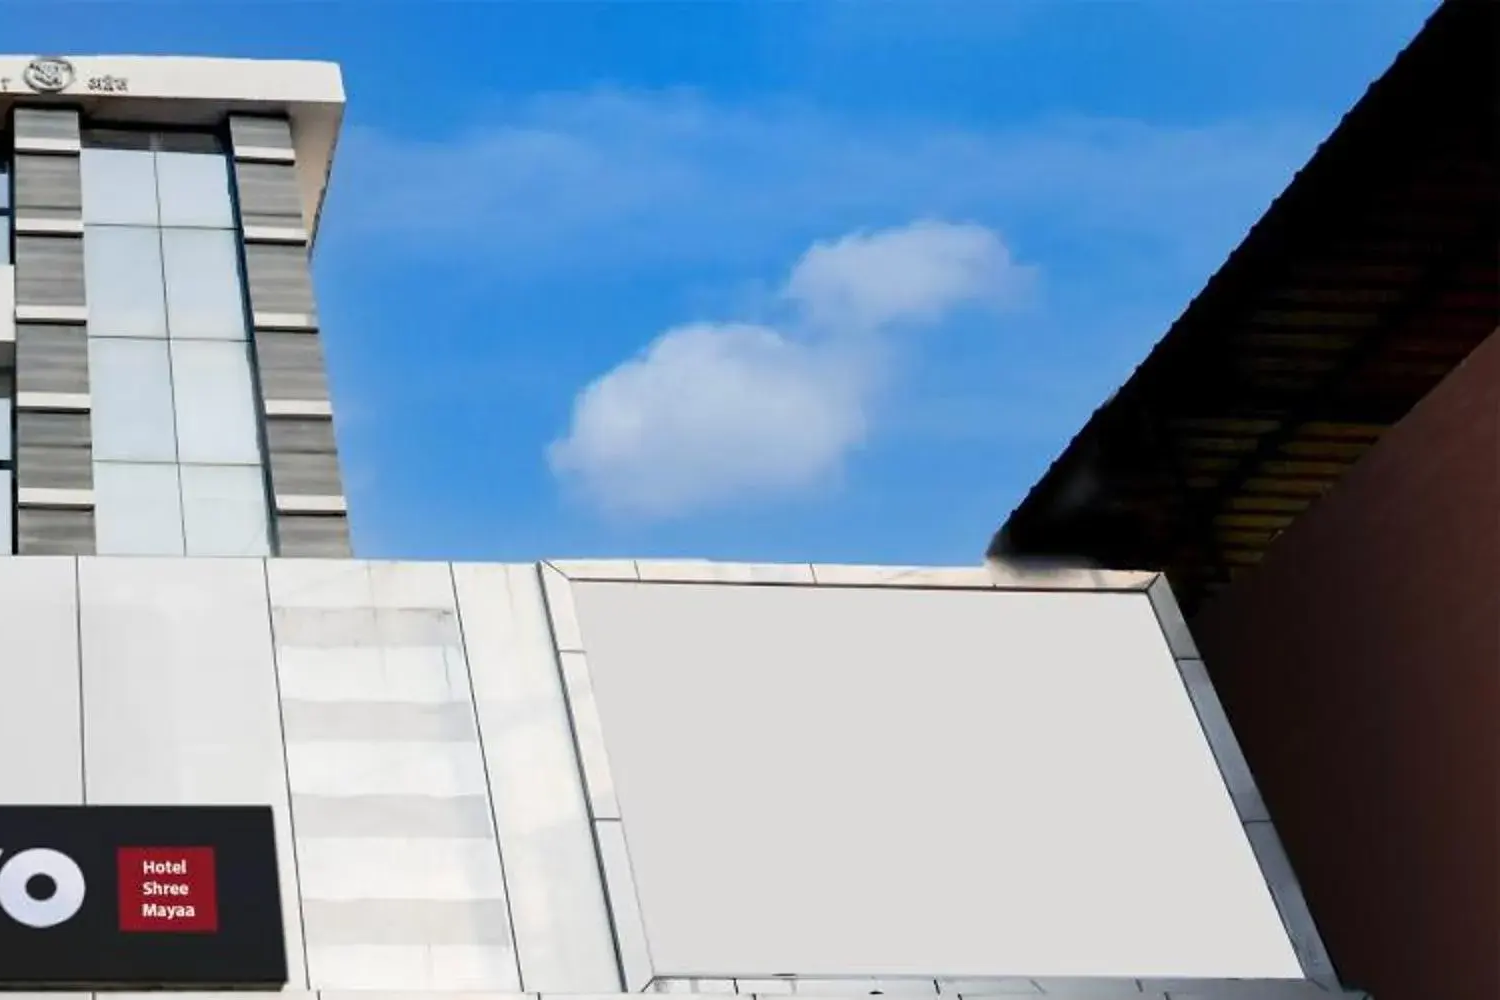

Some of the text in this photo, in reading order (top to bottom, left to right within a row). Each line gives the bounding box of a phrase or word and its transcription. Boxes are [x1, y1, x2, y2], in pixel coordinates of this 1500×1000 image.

[143, 859, 187, 875] Hotel
[142, 880, 189, 895] Shree
[142, 903, 196, 920] Mayaa
